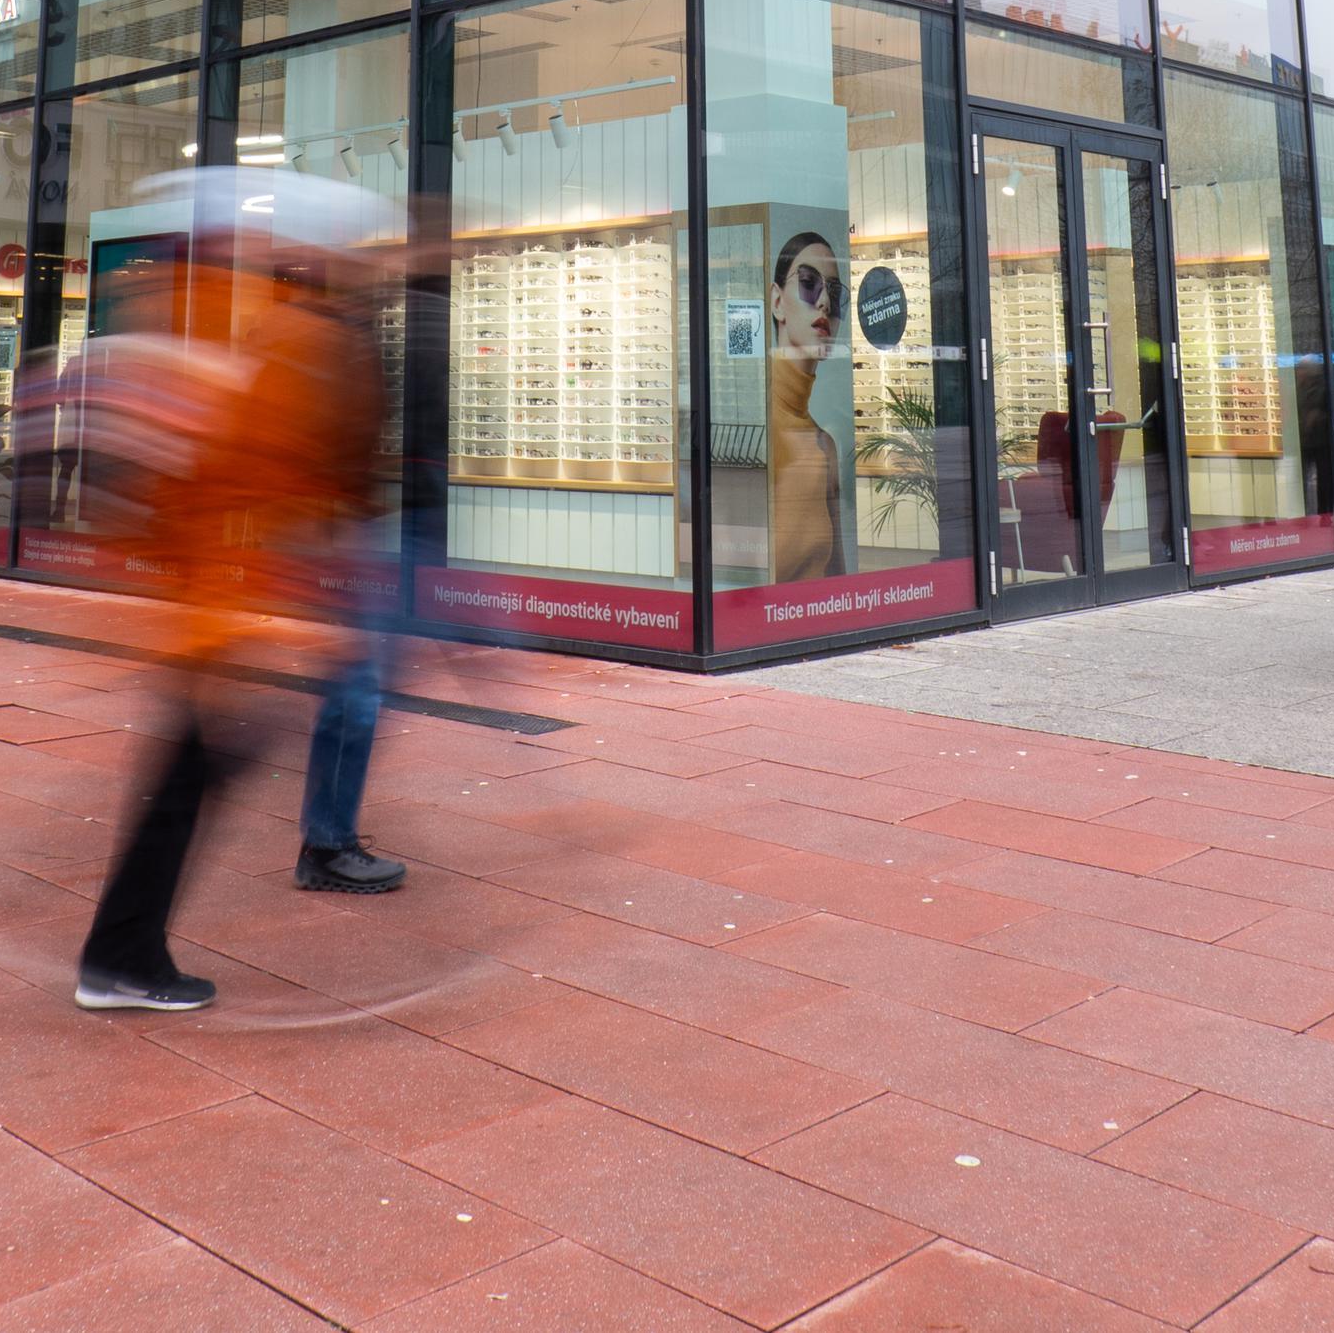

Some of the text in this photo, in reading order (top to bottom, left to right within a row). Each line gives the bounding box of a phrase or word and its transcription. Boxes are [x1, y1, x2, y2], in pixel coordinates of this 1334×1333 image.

[884, 291, 901, 305] zraku
[867, 304, 901, 326] zdarma
[1256, 535, 1275, 550] zraku
[1276, 532, 1300, 547] zdarma
[318, 573, 398, 597] www.alensa.cz
[434, 585, 680, 630] Nejmodernější diagnostické vybavení
[764, 581, 934, 623] Tisíce modelů brýlí skladem!
